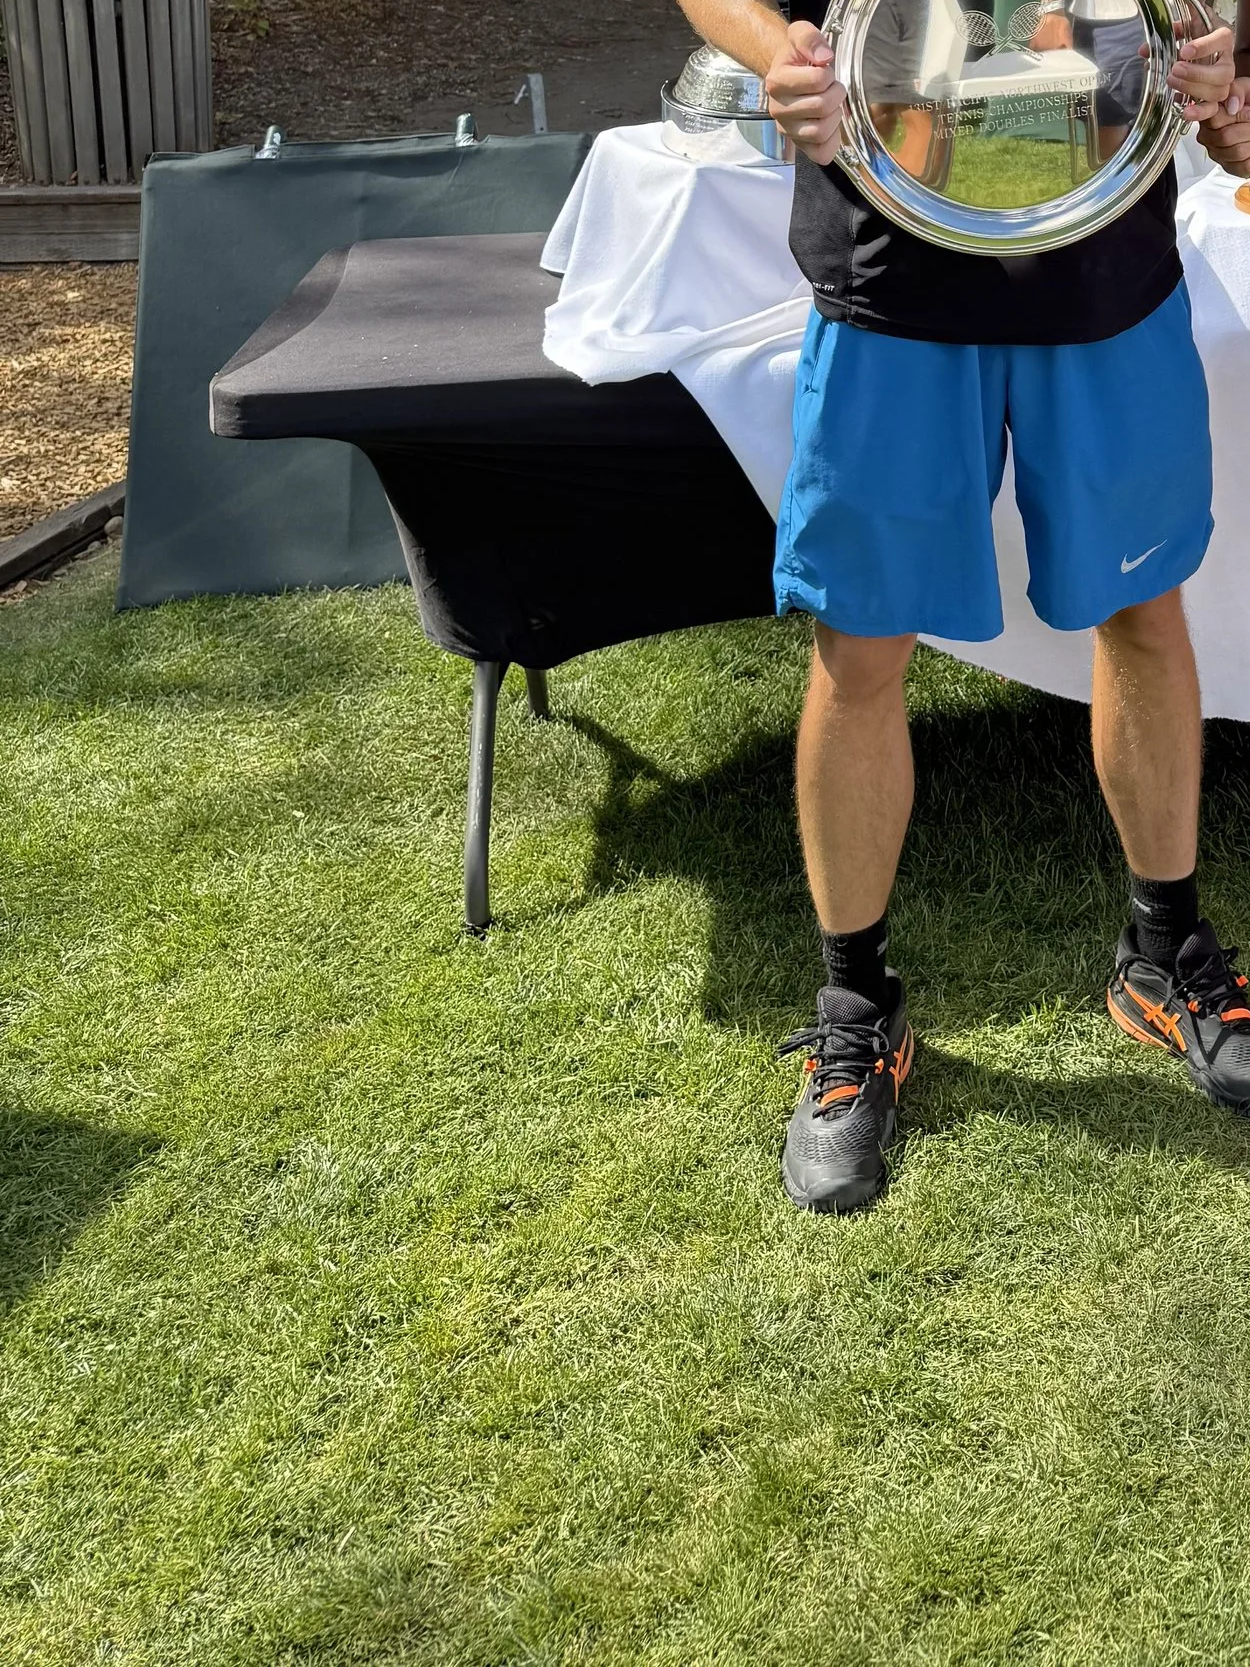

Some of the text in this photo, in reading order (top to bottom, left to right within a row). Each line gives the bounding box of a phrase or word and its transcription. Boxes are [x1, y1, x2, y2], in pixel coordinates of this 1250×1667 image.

[1000, 78, 1076, 101] NORTHWEST
[933, 105, 1093, 140] MIXED DOUBLES FINALIST
[938, 91, 1089, 125] TENNIS CHAMPIONSHIPS
